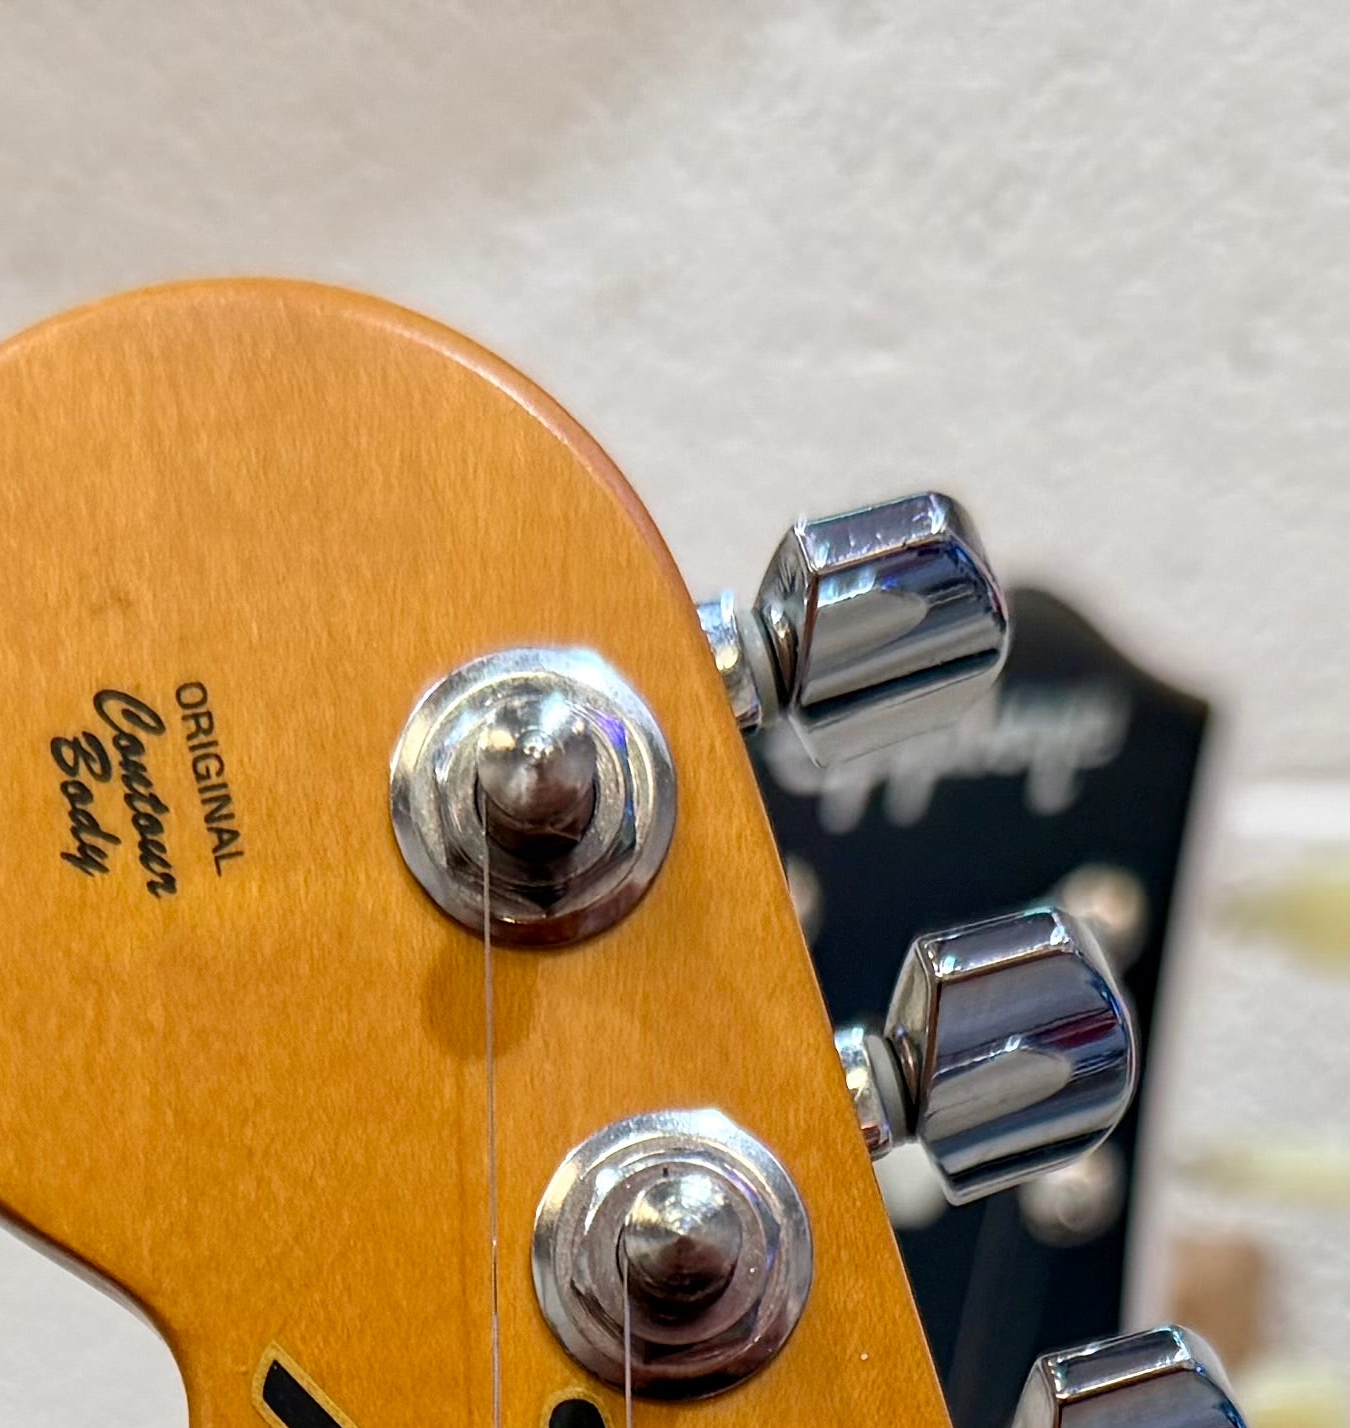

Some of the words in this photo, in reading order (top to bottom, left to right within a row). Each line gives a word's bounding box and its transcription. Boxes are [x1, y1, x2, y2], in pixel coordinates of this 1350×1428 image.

[51, 731, 122, 877] Body
[93, 689, 177, 898] Contour
[174, 681, 245, 877] ORIGINAL
